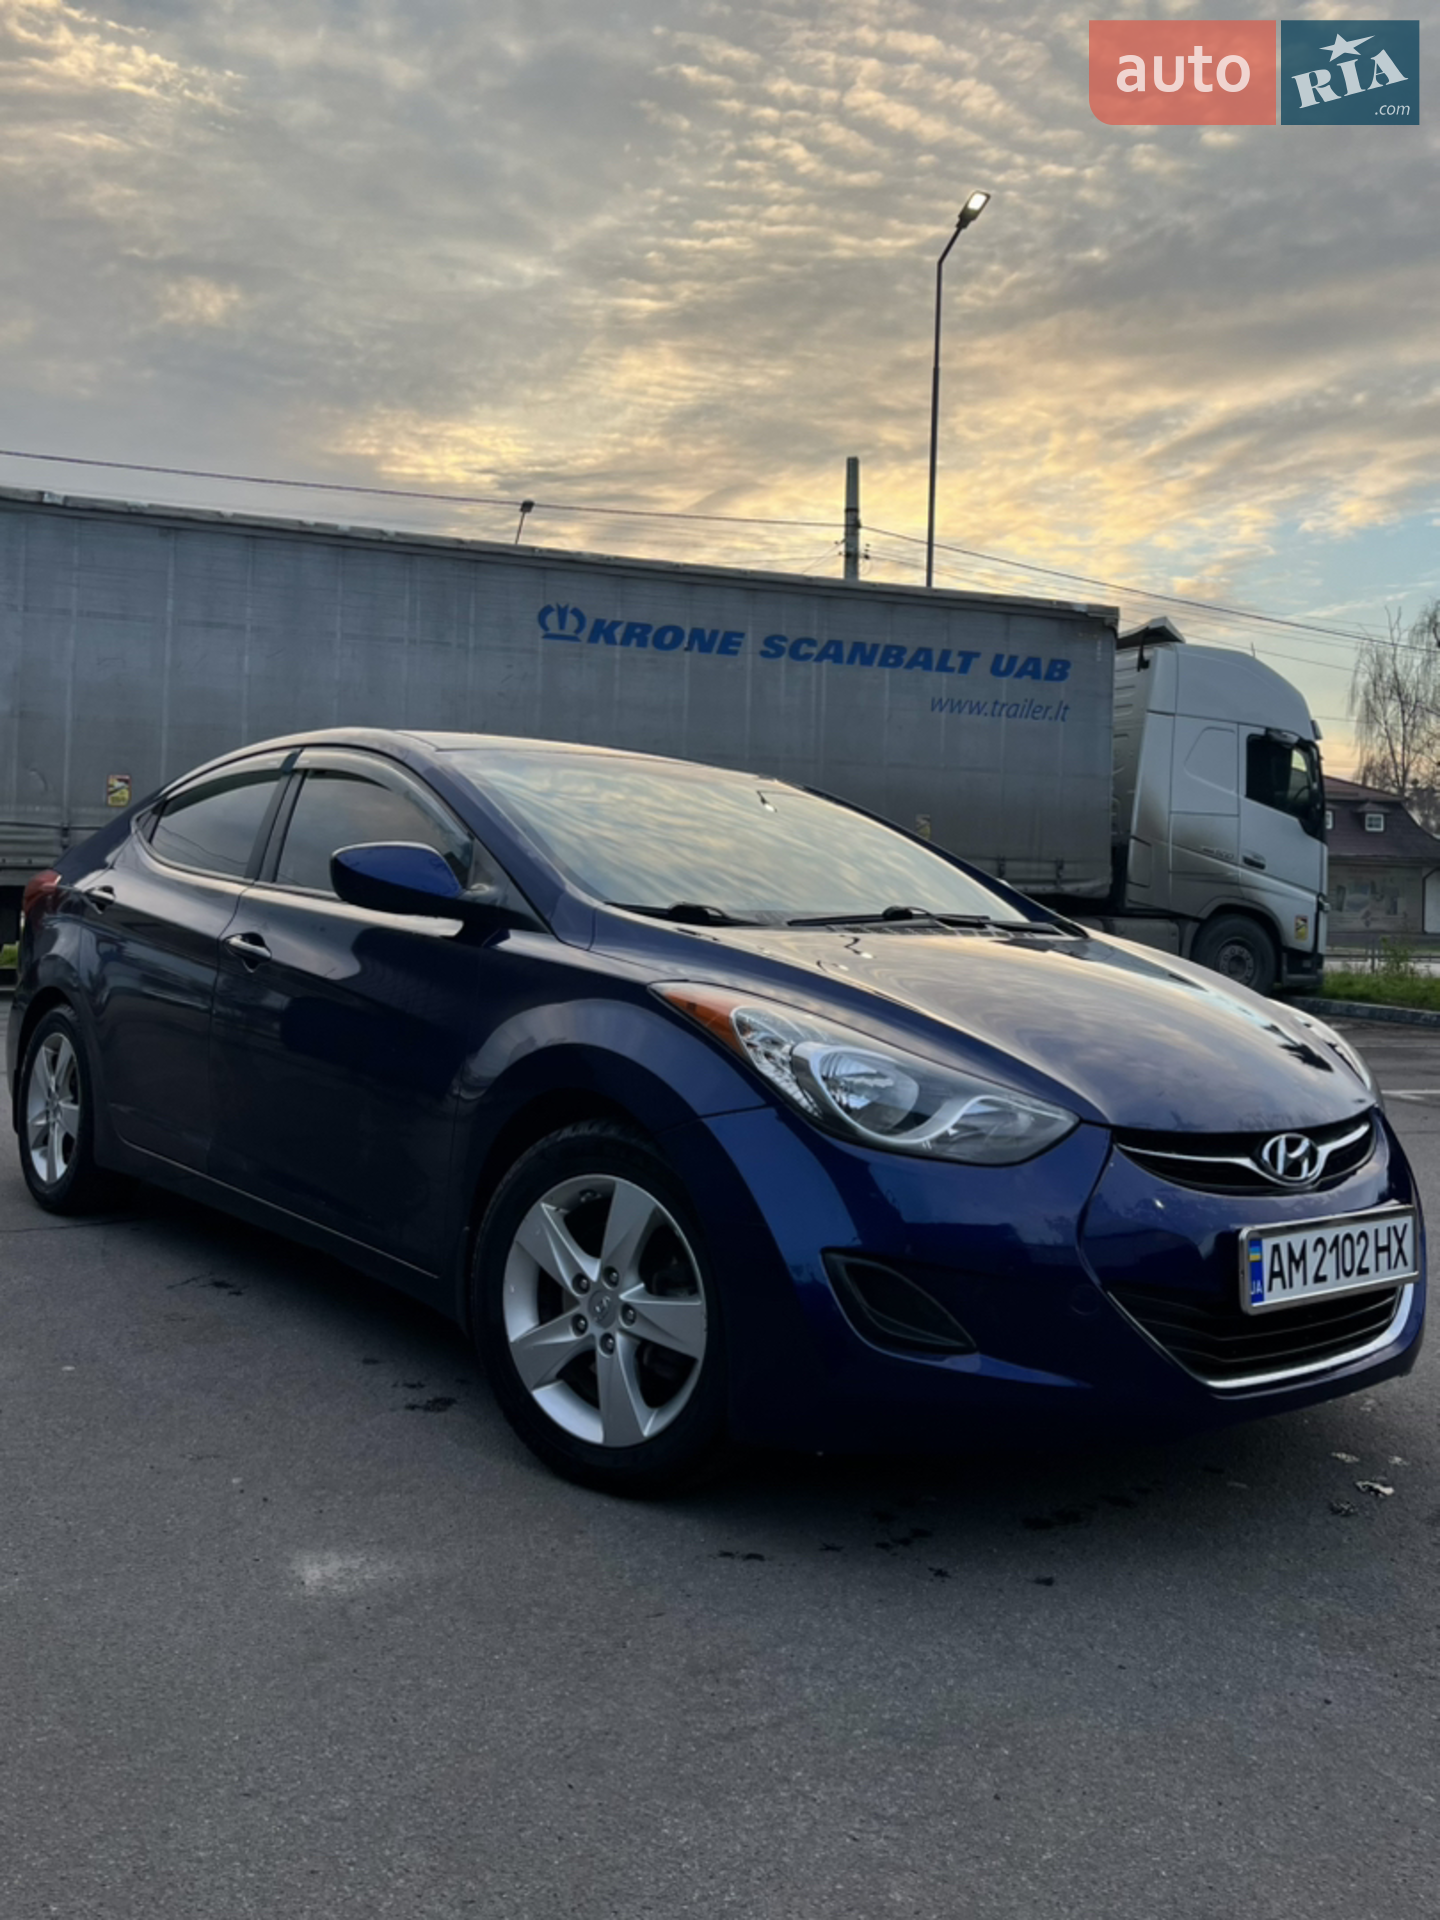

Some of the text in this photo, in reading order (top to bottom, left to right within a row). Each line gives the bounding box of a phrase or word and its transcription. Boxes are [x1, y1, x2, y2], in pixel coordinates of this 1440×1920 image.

[587, 618, 1071, 682] KRONE SCANBALT UAB
[930, 697, 1070, 722] www.trailer.lt
